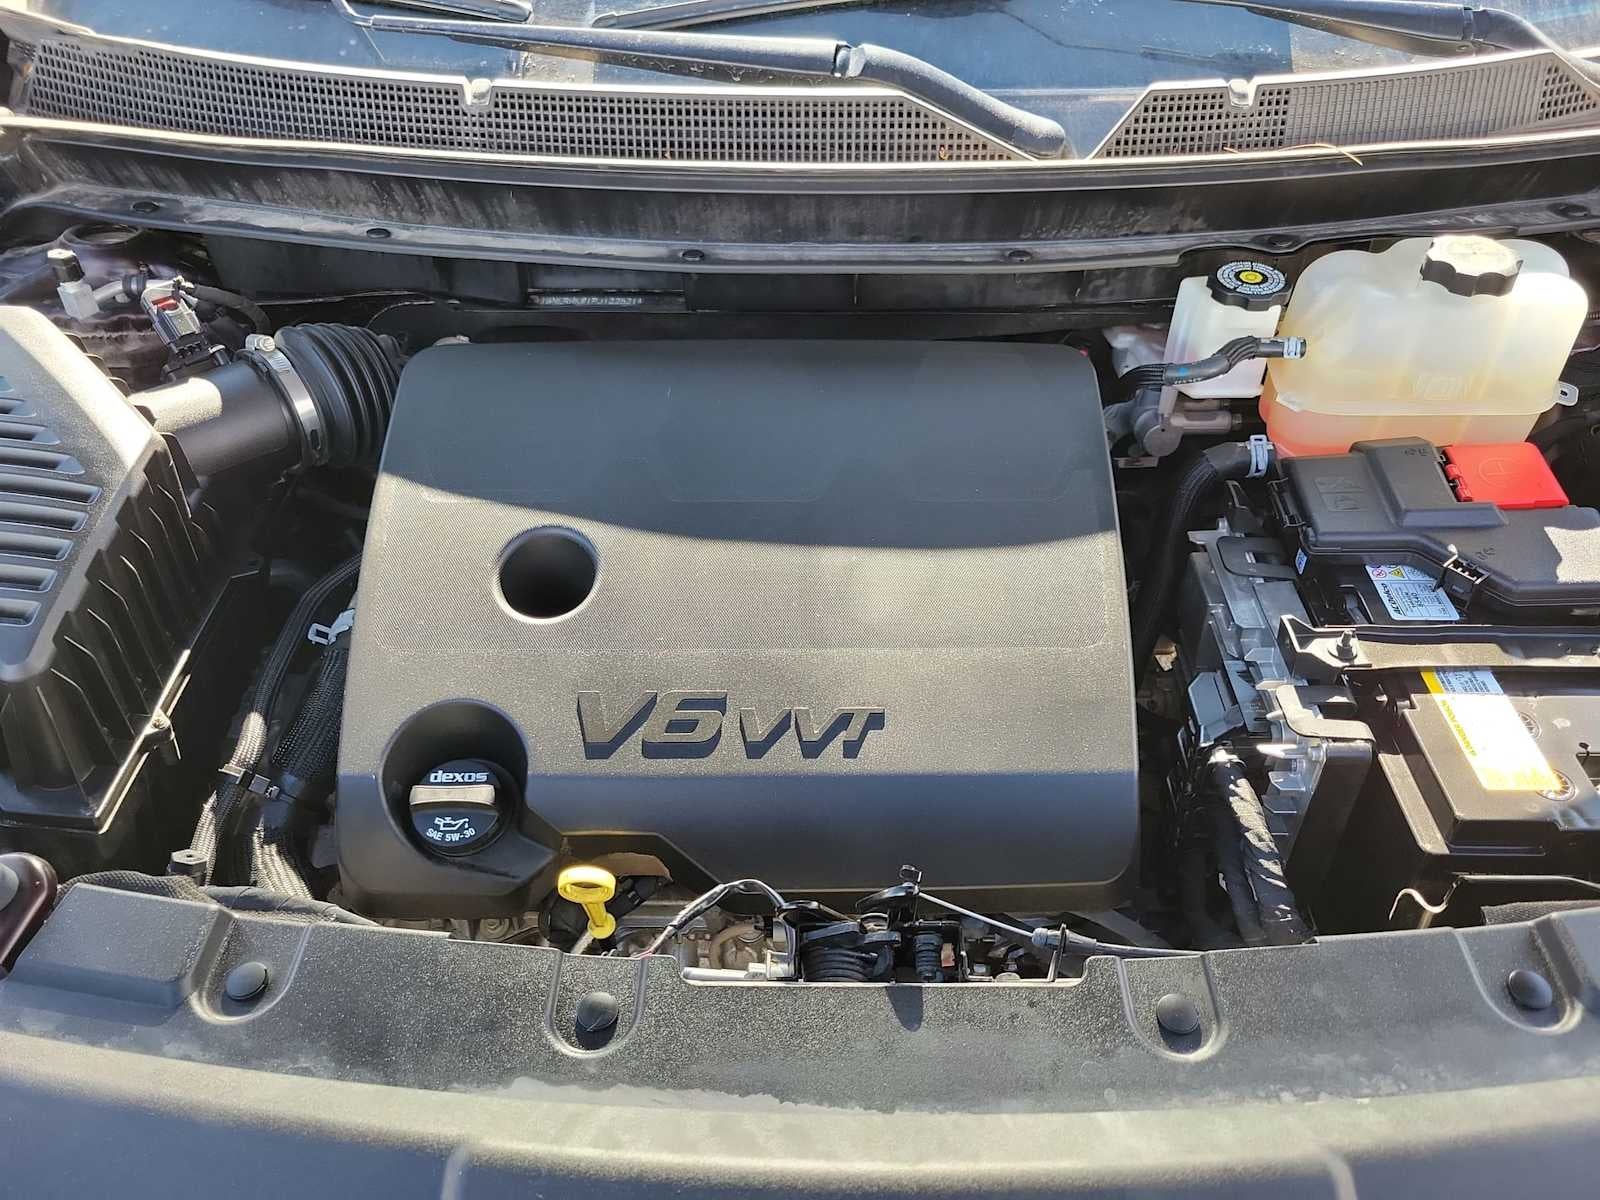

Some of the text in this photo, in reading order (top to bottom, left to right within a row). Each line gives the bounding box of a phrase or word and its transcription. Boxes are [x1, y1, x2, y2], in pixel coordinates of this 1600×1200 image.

[577, 690, 885, 759] V6 VVT
[430, 770, 489, 782] dexos
[426, 828, 476, 841] SAE 5W-30
